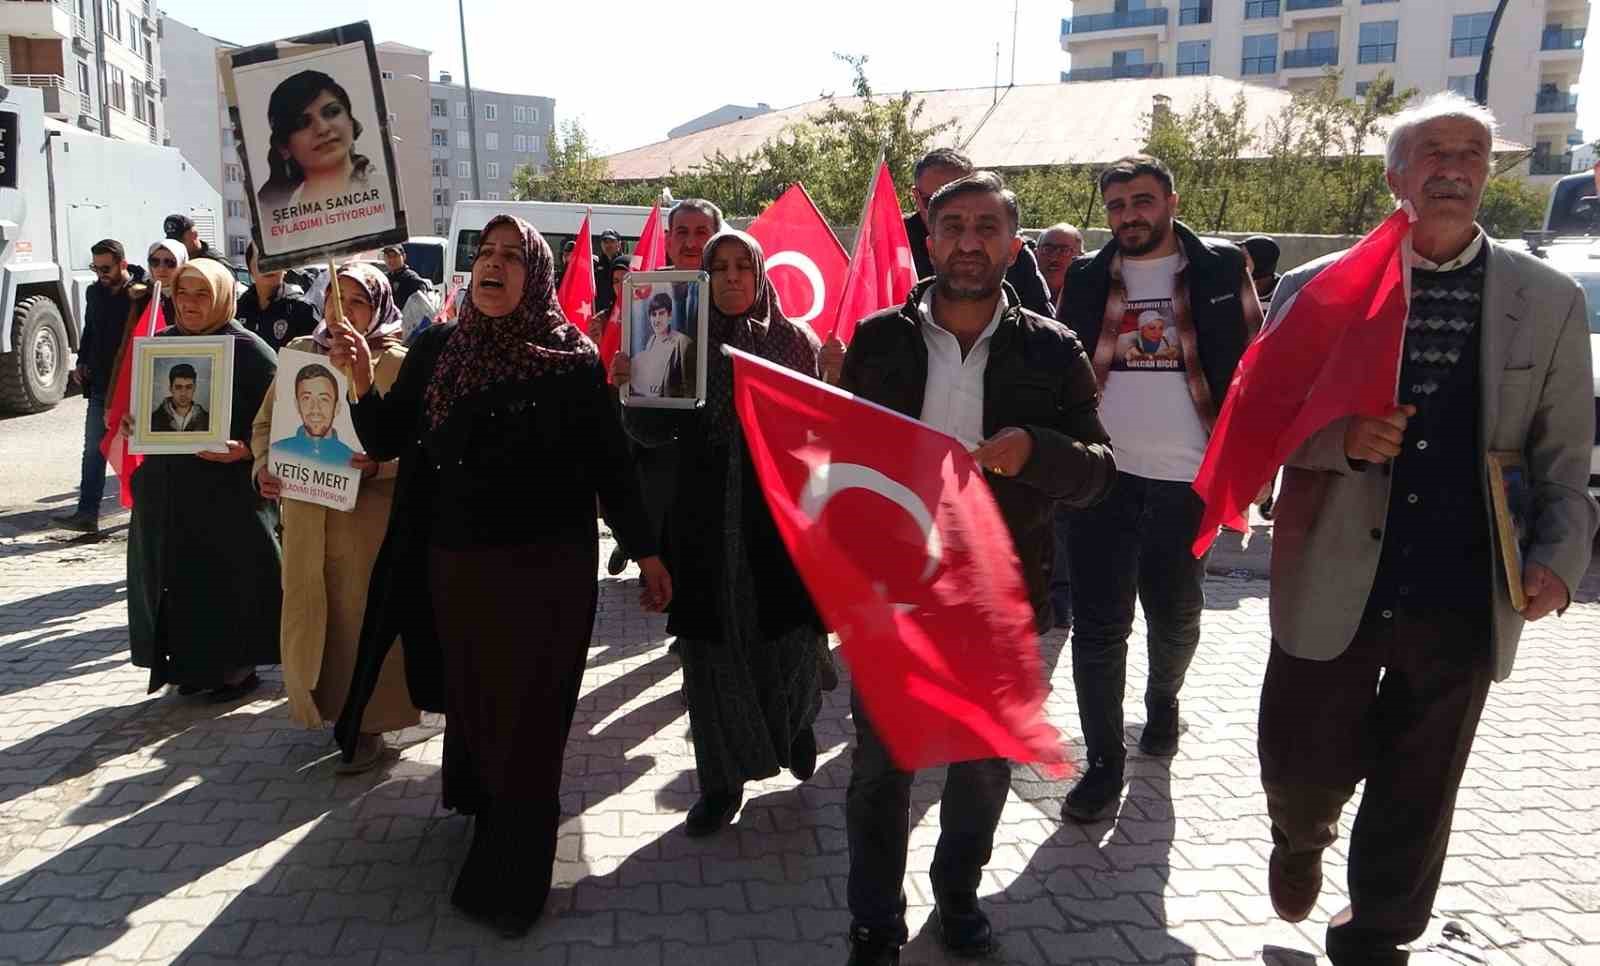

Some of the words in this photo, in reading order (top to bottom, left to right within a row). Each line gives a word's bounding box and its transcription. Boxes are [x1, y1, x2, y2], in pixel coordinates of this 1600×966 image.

[272, 202, 323, 224] ŞERİMA
[326, 188, 380, 209] SANCAR
[271, 218, 323, 236] EVLADIMI
[274, 461, 310, 485] YETİŞ
[313, 470, 350, 491] MERT
